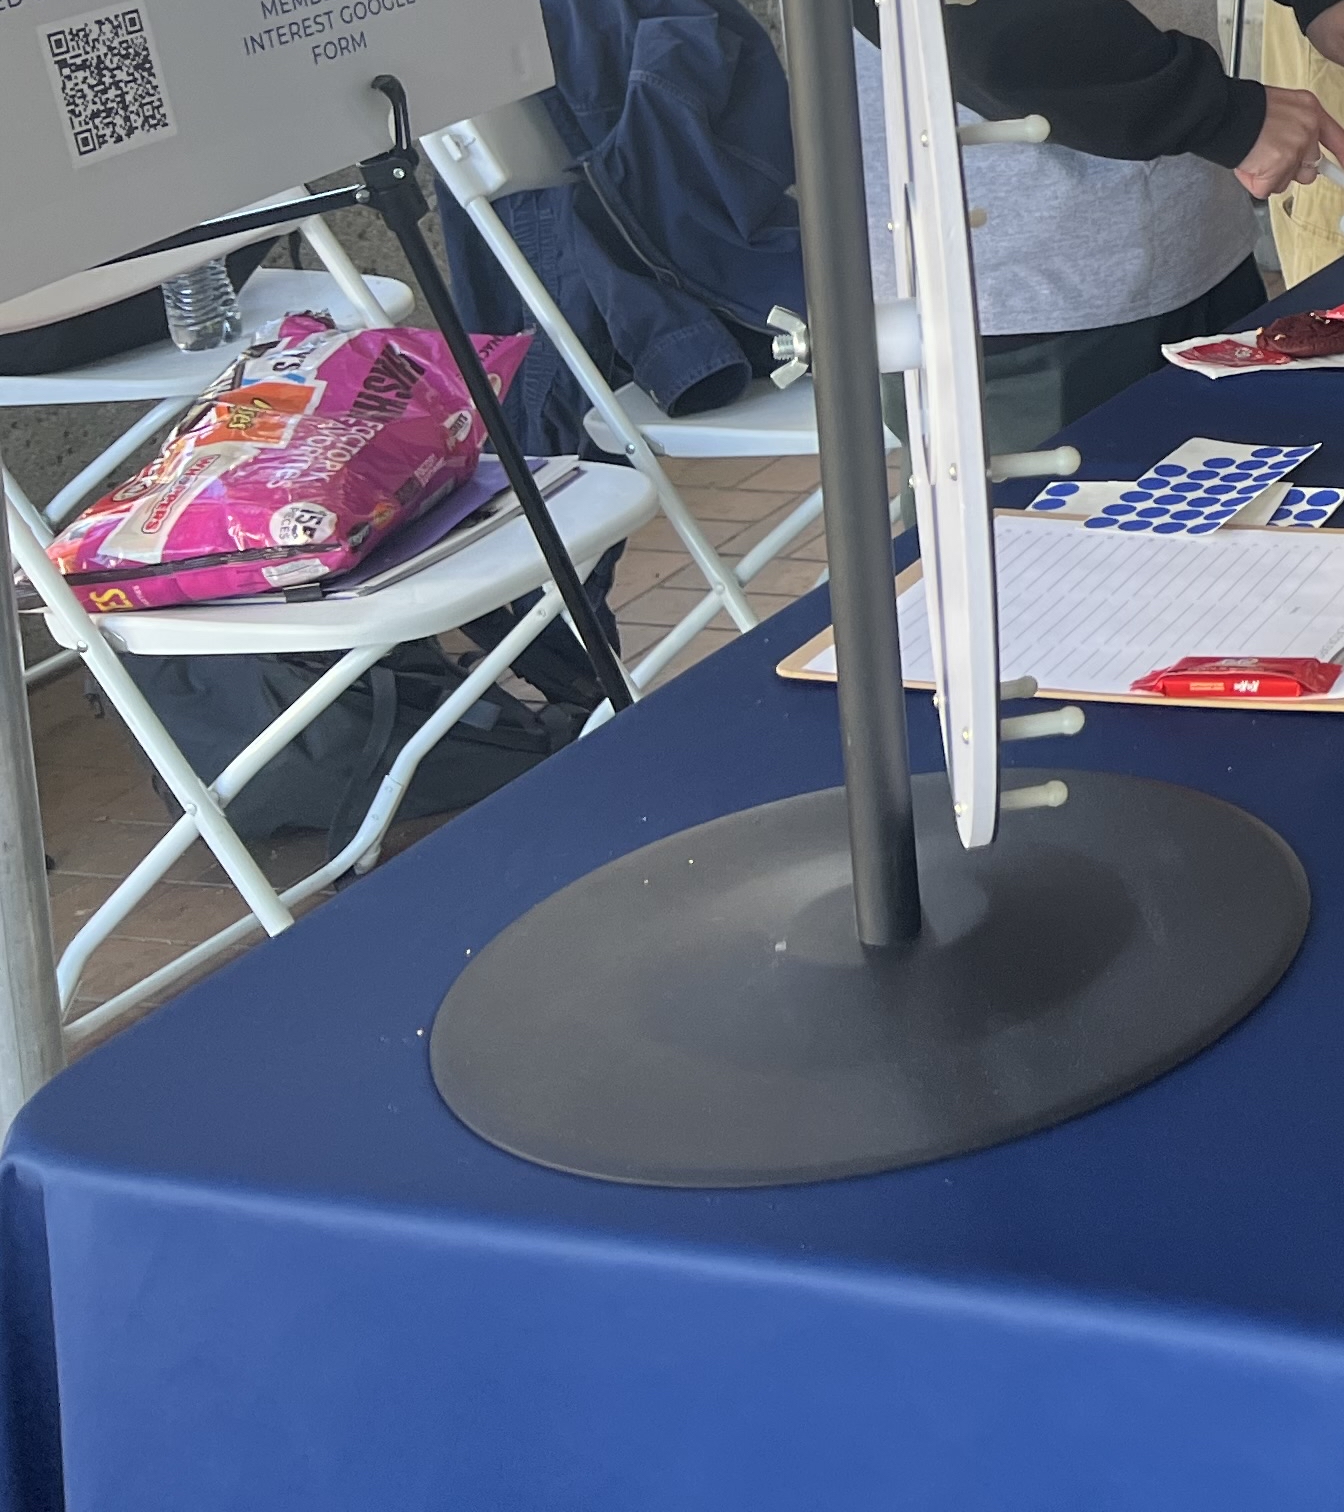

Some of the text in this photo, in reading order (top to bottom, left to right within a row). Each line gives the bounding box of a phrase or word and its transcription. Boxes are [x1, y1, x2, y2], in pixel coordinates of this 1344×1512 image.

[242, 14, 336, 56] INTEREST
[311, 31, 368, 65] FORM
[265, 416, 352, 488] FAVORITES
[306, 417, 384, 482] FACTORY
